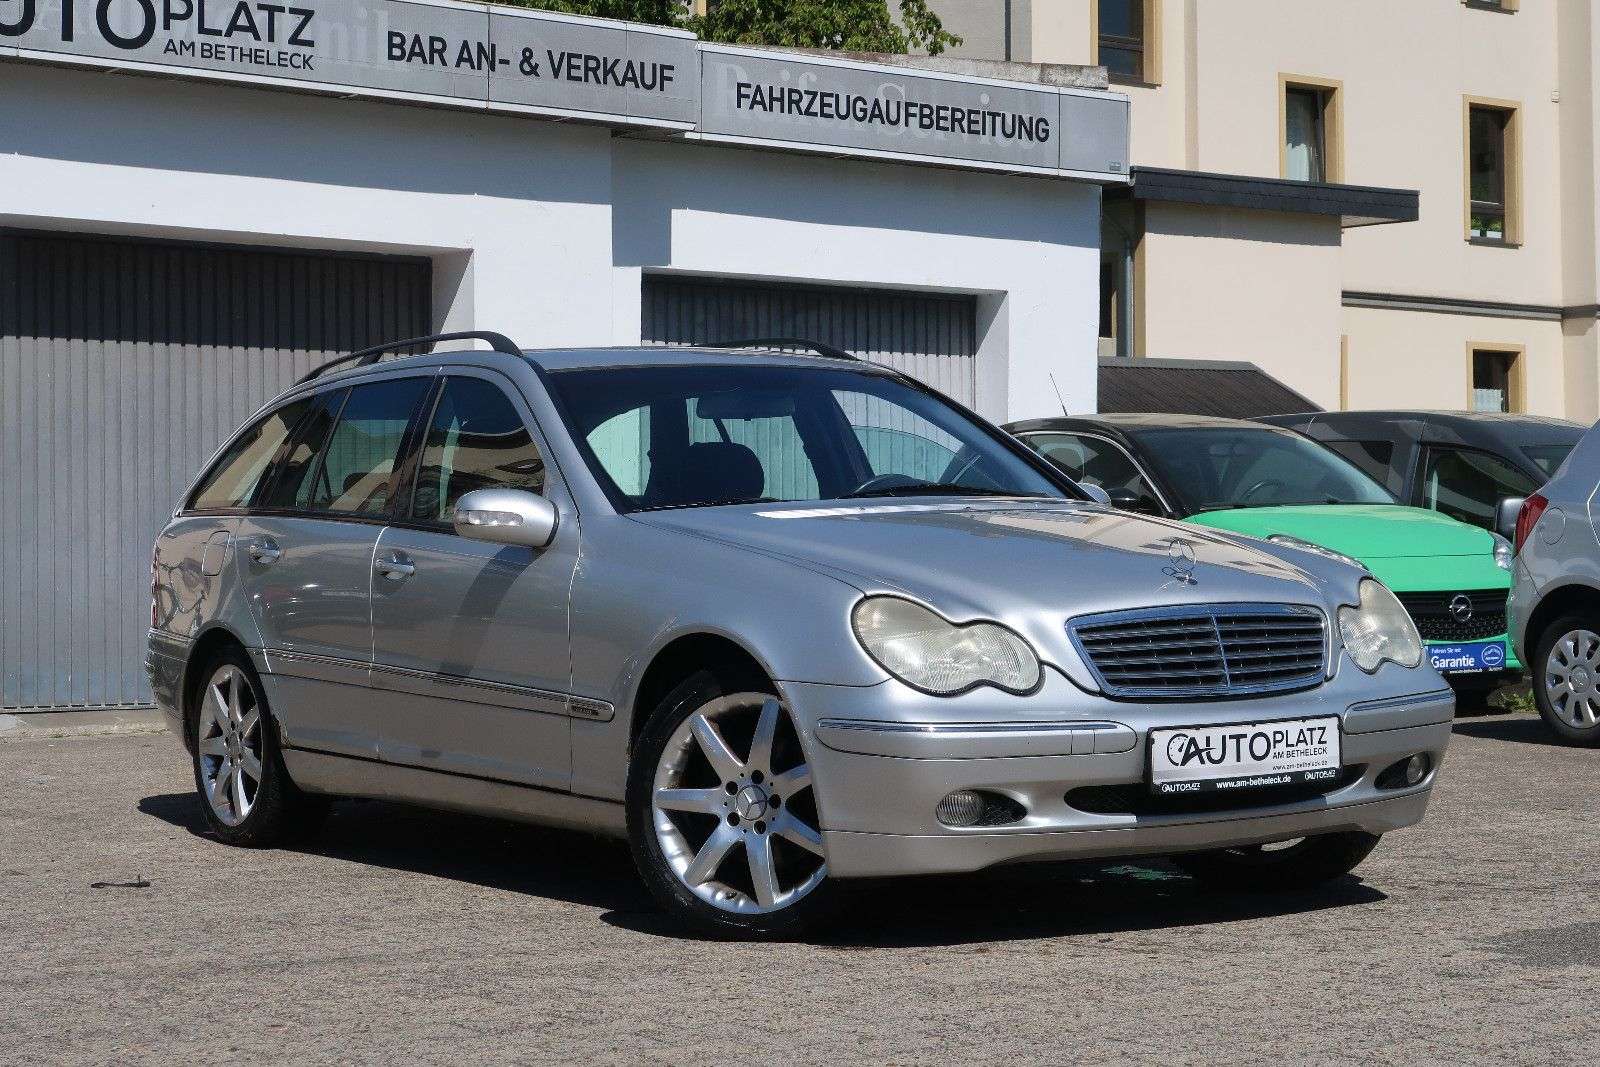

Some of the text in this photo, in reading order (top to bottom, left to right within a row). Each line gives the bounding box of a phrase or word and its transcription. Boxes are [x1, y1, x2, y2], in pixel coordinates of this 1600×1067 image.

[163, 38, 315, 70] AM BETHELECK
[387, 30, 447, 66] BAR
[455, 40, 510, 72] AN-
[519, 47, 541, 77] &
[547, 49, 675, 92] VERKAUF
[736, 81, 1051, 143] FAHRZEUGAUFBEREITUNG
[1431, 654, 1475, 668] Garantie
[1272, 746, 1328, 759] AM BETHELECK
